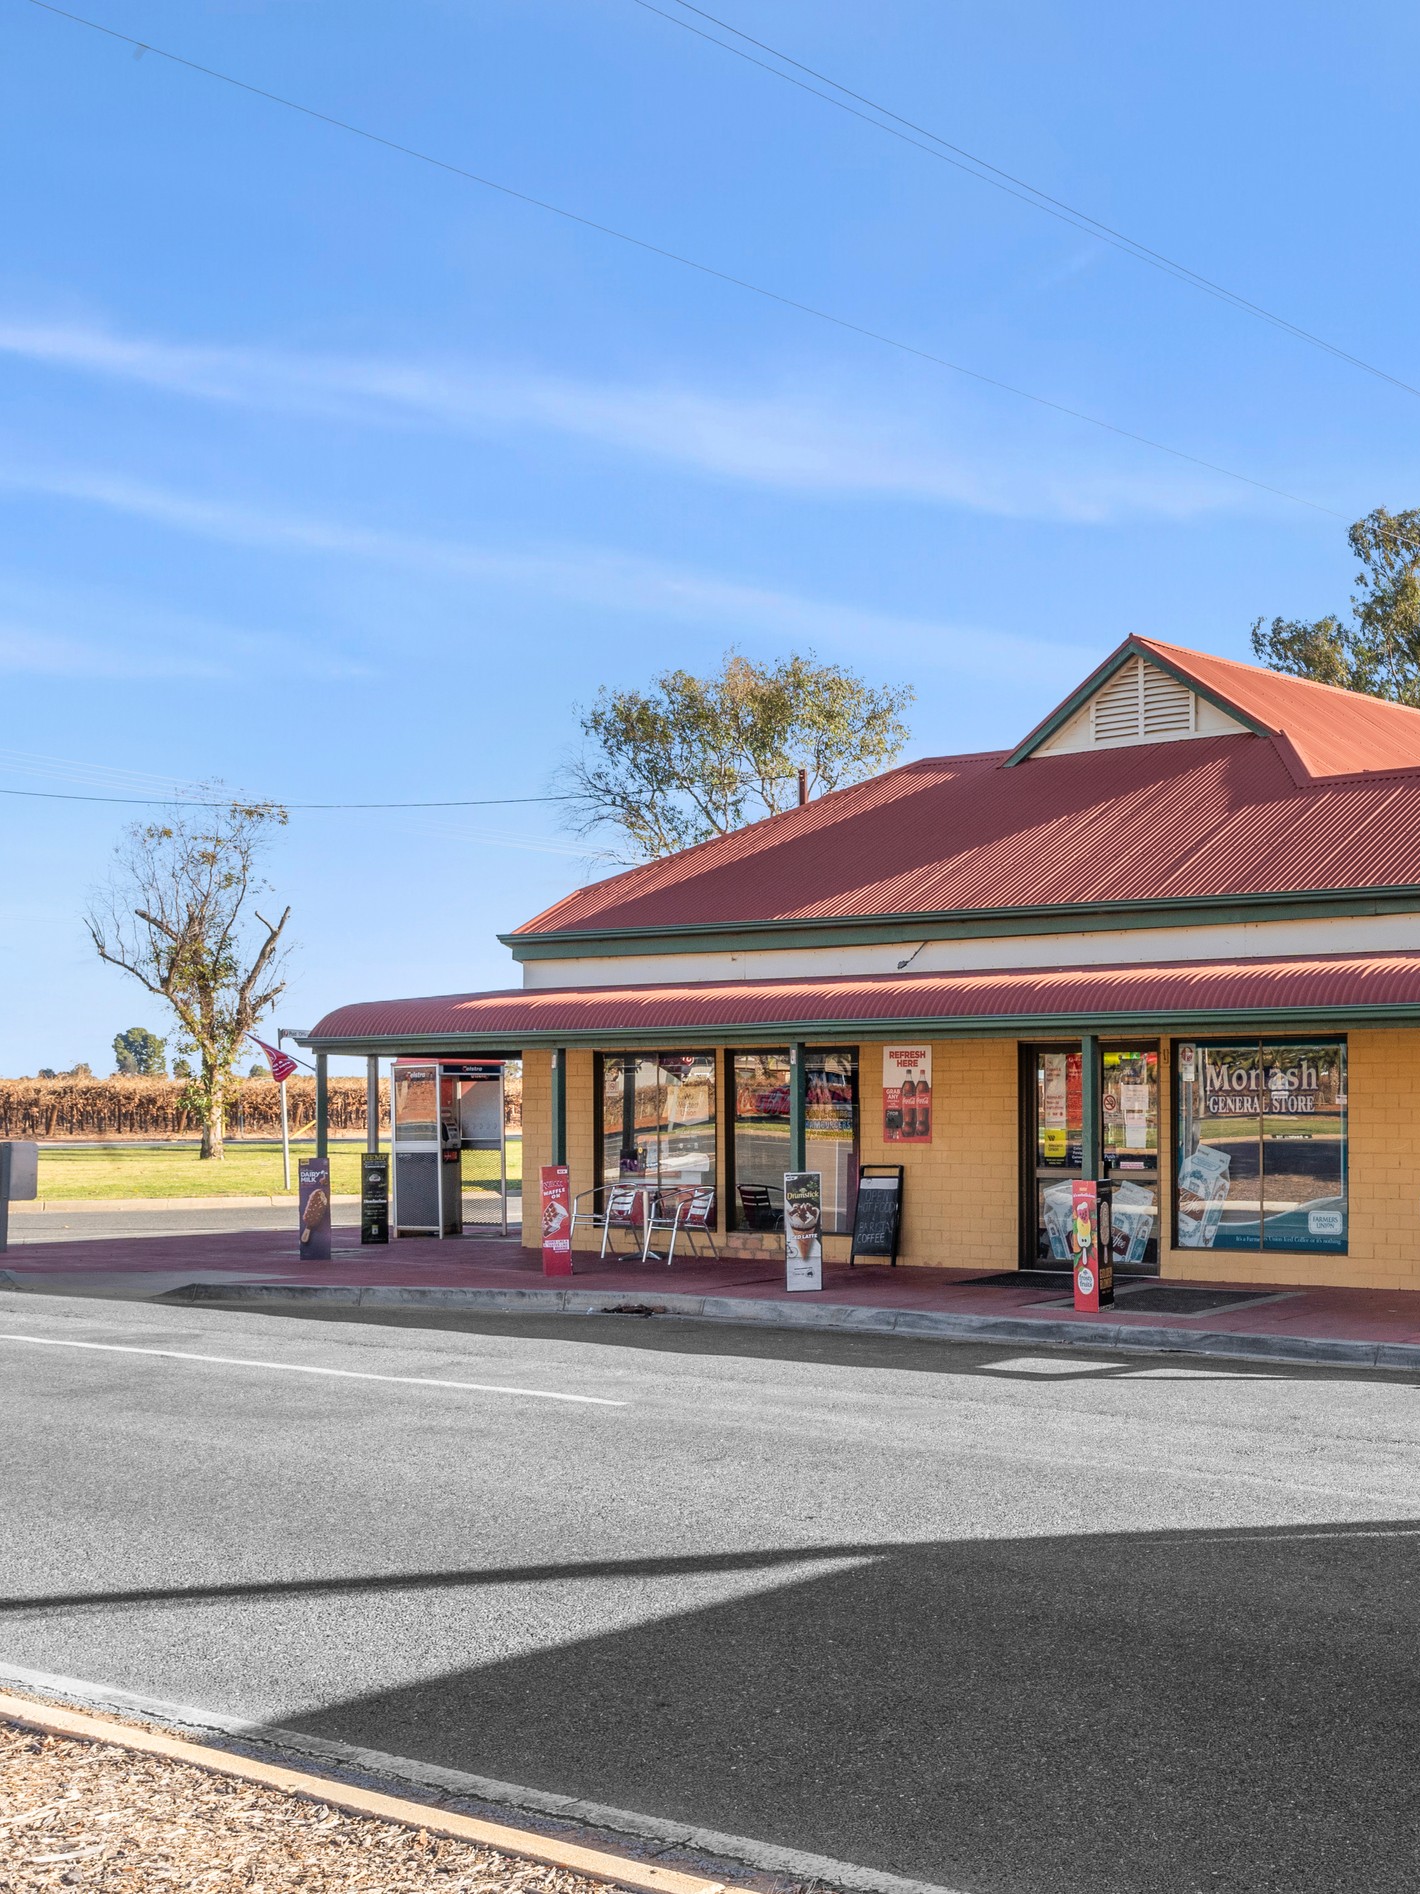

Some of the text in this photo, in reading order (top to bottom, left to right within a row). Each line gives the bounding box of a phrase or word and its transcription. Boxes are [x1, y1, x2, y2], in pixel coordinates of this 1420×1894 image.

[889, 1051, 926, 1059] REFRESH
[1206, 1060, 1319, 1091] Monash
[1209, 1096, 1316, 1114] GENERAL STORE
[543, 1187, 566, 1196] WAFFLE
[787, 1191, 819, 1200] Drumstick
[856, 1232, 885, 1244] COFFEE
